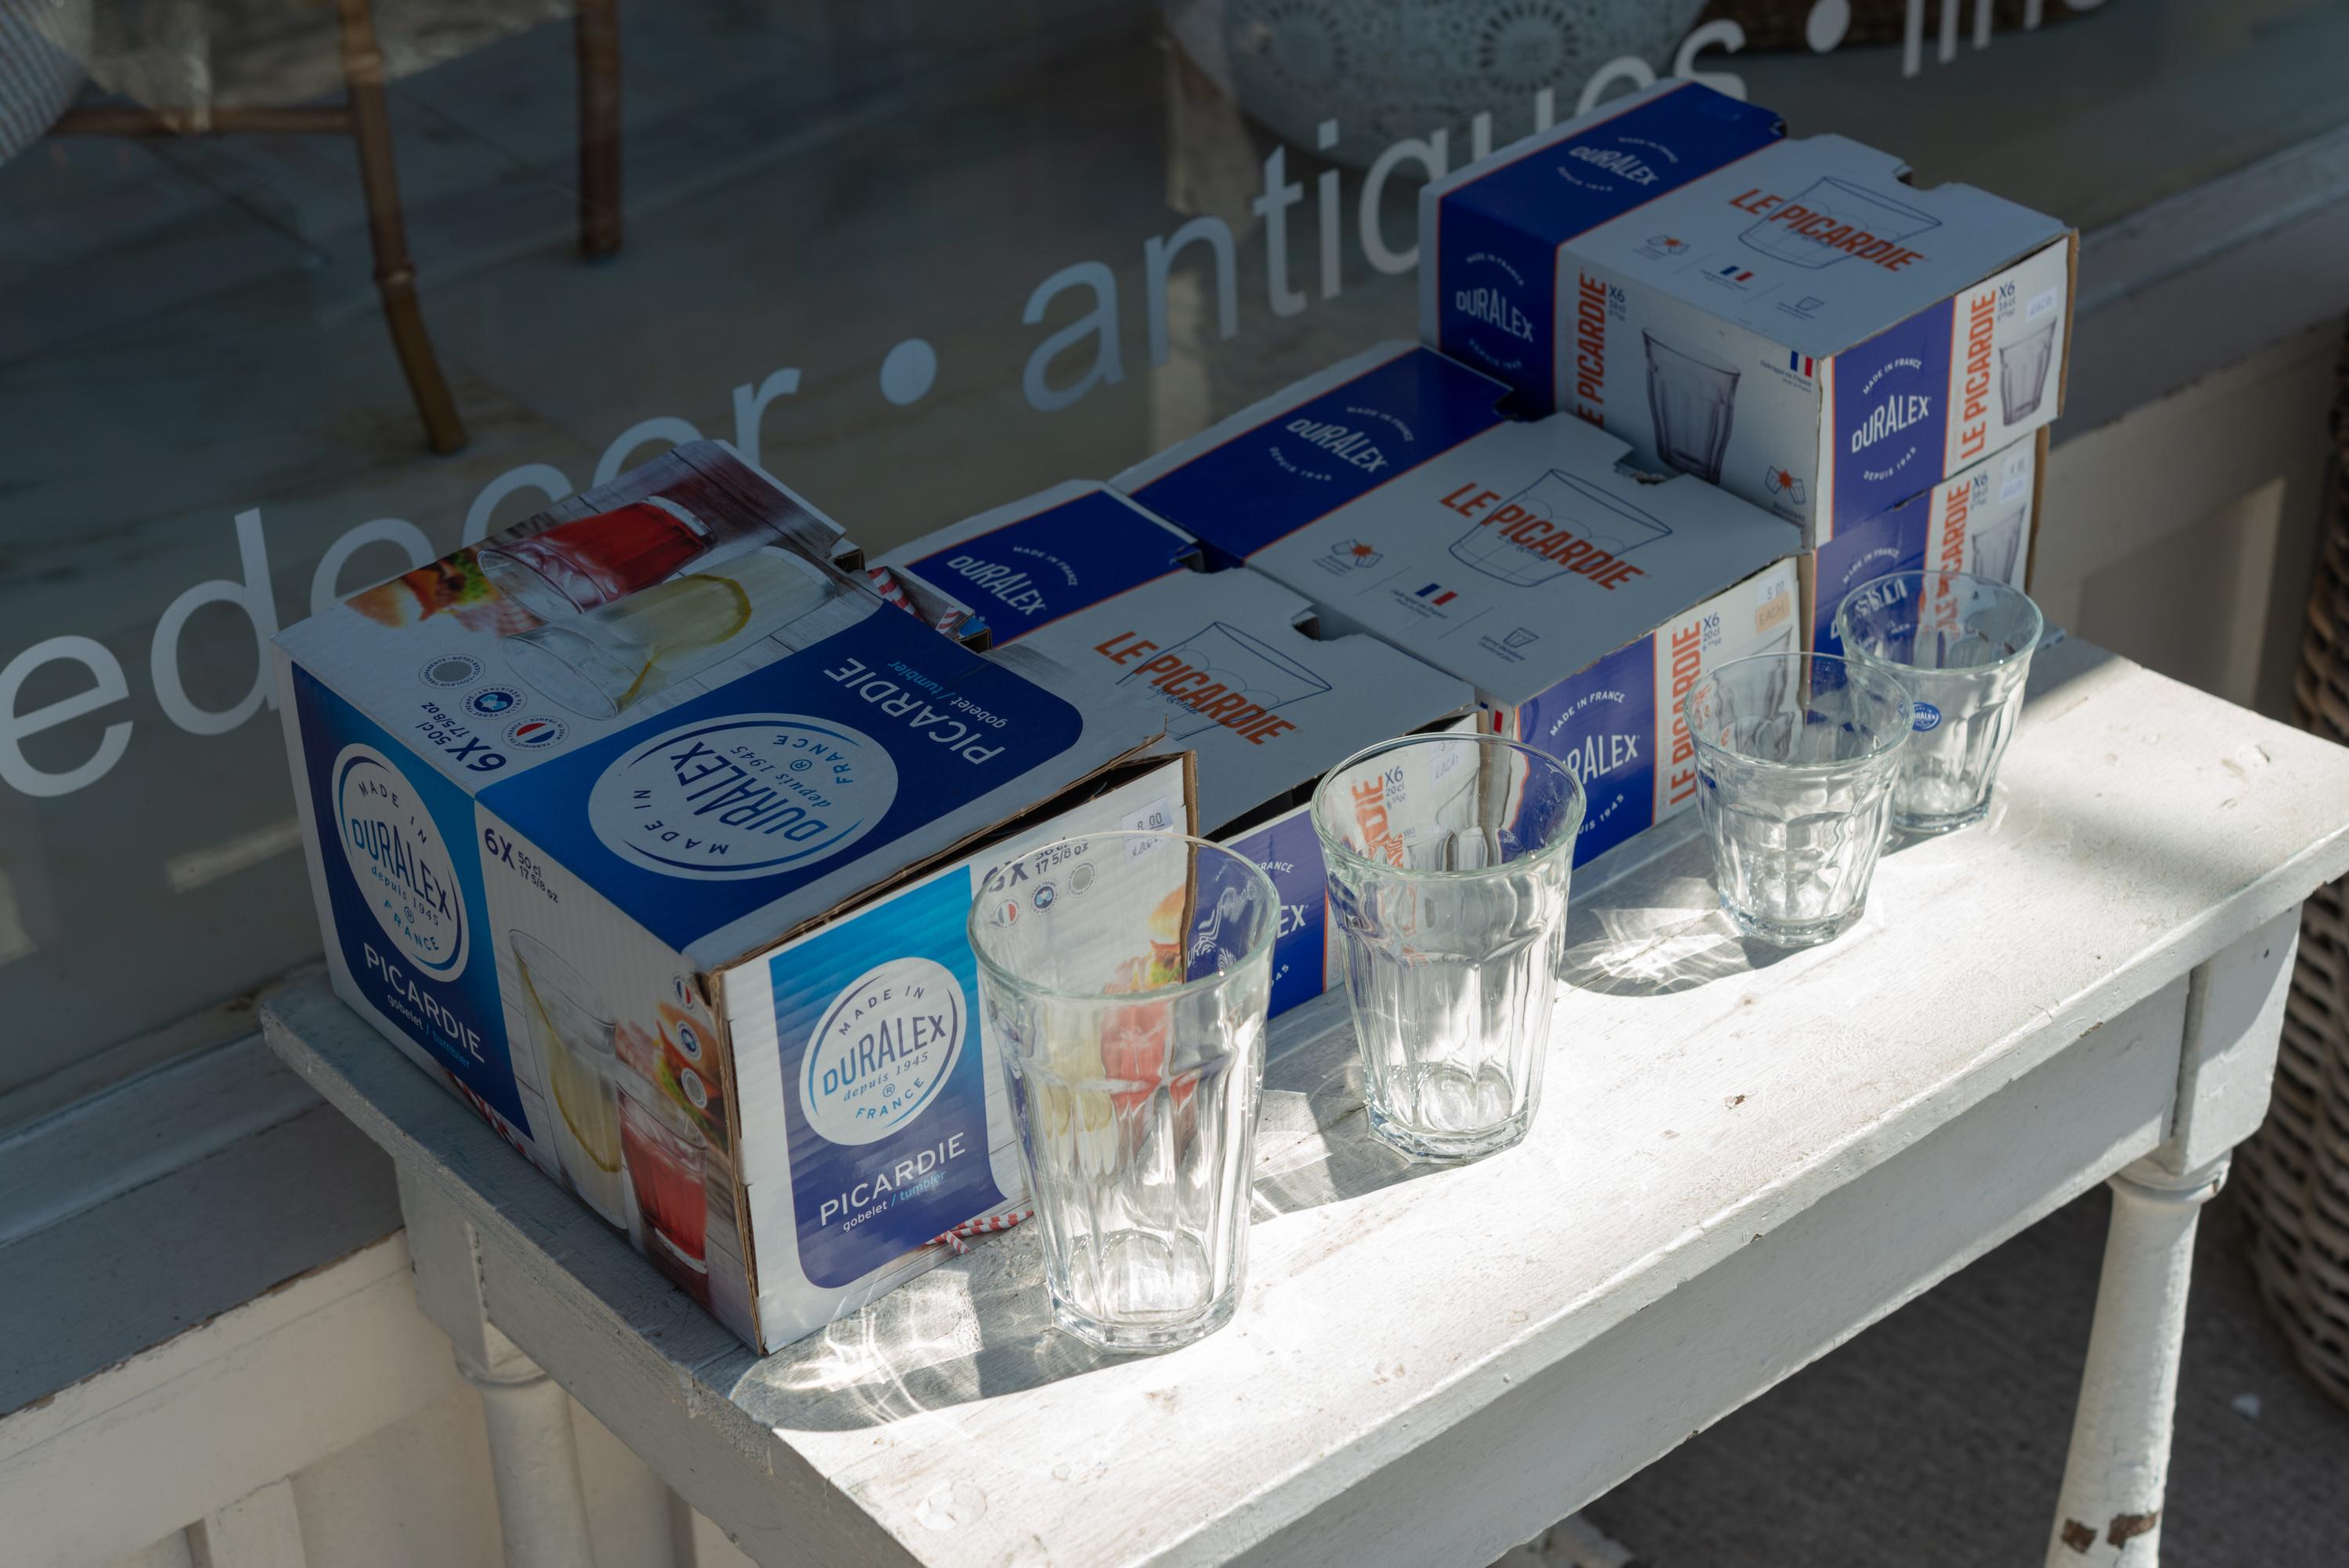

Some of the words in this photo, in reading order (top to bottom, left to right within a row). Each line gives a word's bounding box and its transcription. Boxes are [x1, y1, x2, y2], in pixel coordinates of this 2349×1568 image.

[1728, 187, 1785, 216] LE
[1768, 203, 1925, 272] PICARDIE
[1608, 283, 1626, 304] X6
[1997, 279, 2016, 297] X6
[1456, 287, 1535, 344] DURALEX
[1576, 271, 1607, 404] PICARDIE
[1863, 369, 1883, 395] MADE
[1884, 361, 1893, 373] IN
[1894, 357, 1922, 370] FRANCE
[1964, 288, 1997, 421] PICARDIE
[1286, 418, 1386, 473] DURALEX
[1852, 395, 1930, 453] DURALEX
[1960, 420, 1987, 460] LE
[1438, 481, 1502, 518] LE
[1480, 503, 1645, 591] PICARDIE
[947, 555, 1045, 615] DURALEX
[1702, 611, 1721, 632] X6
[887, 660, 940, 698] tumbler
[1093, 629, 1160, 666] LE
[1133, 654, 1297, 746] PICARDIE
[824, 658, 1005, 766] PICARDIE
[948, 697, 1009, 730] gobelet
[1549, 706, 1575, 737] MADE
[1575, 697, 1588, 710] IN
[1589, 690, 1626, 705] FRANCE
[444, 736, 507, 772] 6X
[730, 744, 778, 775] 1945
[771, 733, 853, 785] FRANCE
[1384, 766, 1404, 788] X6
[358, 780, 399, 808] MADE
[410, 815, 428, 845] IN
[632, 788, 652, 809] IN
[670, 741, 829, 843] DURALEX
[776, 772, 833, 809] depuis
[1600, 794, 1624, 821] 1945
[484, 827, 517, 871] 6X
[643, 820, 729, 855] MADE
[1034, 860, 1049, 876] 17
[1052, 847, 1071, 867] 5/8
[350, 818, 452, 922] DURALEX
[370, 865, 408, 903] depuis
[412, 898, 439, 927] 1945
[383, 899, 440, 951] FRANCE
[363, 942, 485, 1065] PICARDIE
[388, 993, 424, 1032] gobelet
[839, 987, 893, 1036] MADE
[905, 984, 926, 1000] IN
[822, 1014, 947, 1097] DURALEX
[843, 1070, 889, 1103] depuis
[895, 1051, 930, 1076] 1945
[854, 1076, 925, 1121] FRANCE
[820, 1132, 965, 1227] PICARDIE
[843, 1199, 889, 1233] gobelet
[899, 1172, 947, 1201] tumbler
